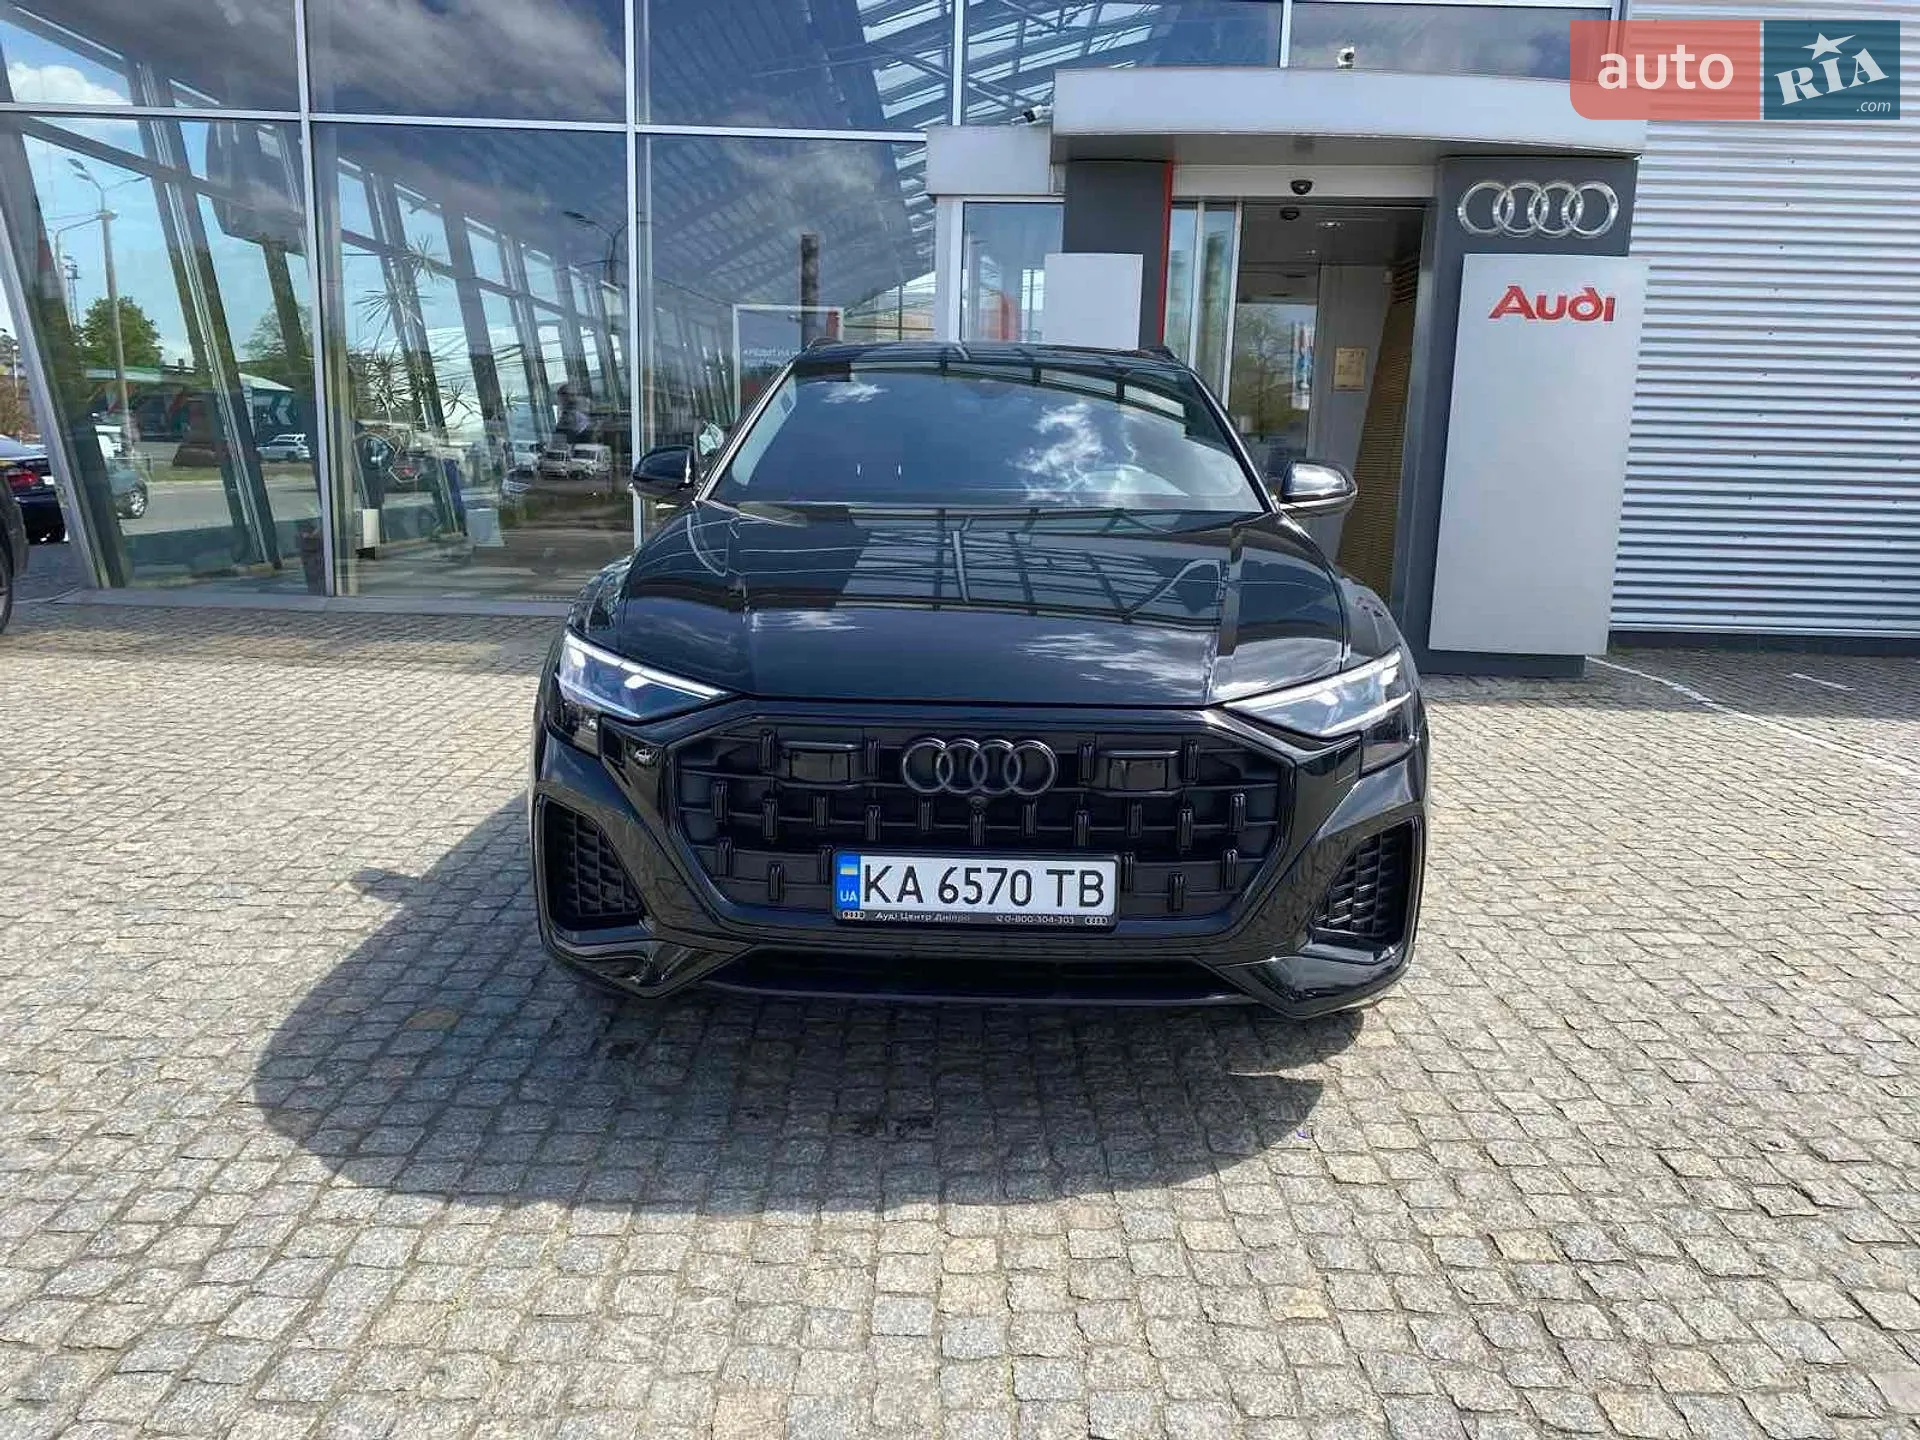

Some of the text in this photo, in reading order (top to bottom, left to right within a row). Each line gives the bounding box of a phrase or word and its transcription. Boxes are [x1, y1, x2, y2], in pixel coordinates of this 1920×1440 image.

[1488, 285, 1616, 321] Audi
[840, 890, 858, 902] UA
[864, 864, 1104, 907] KA 6570 TB
